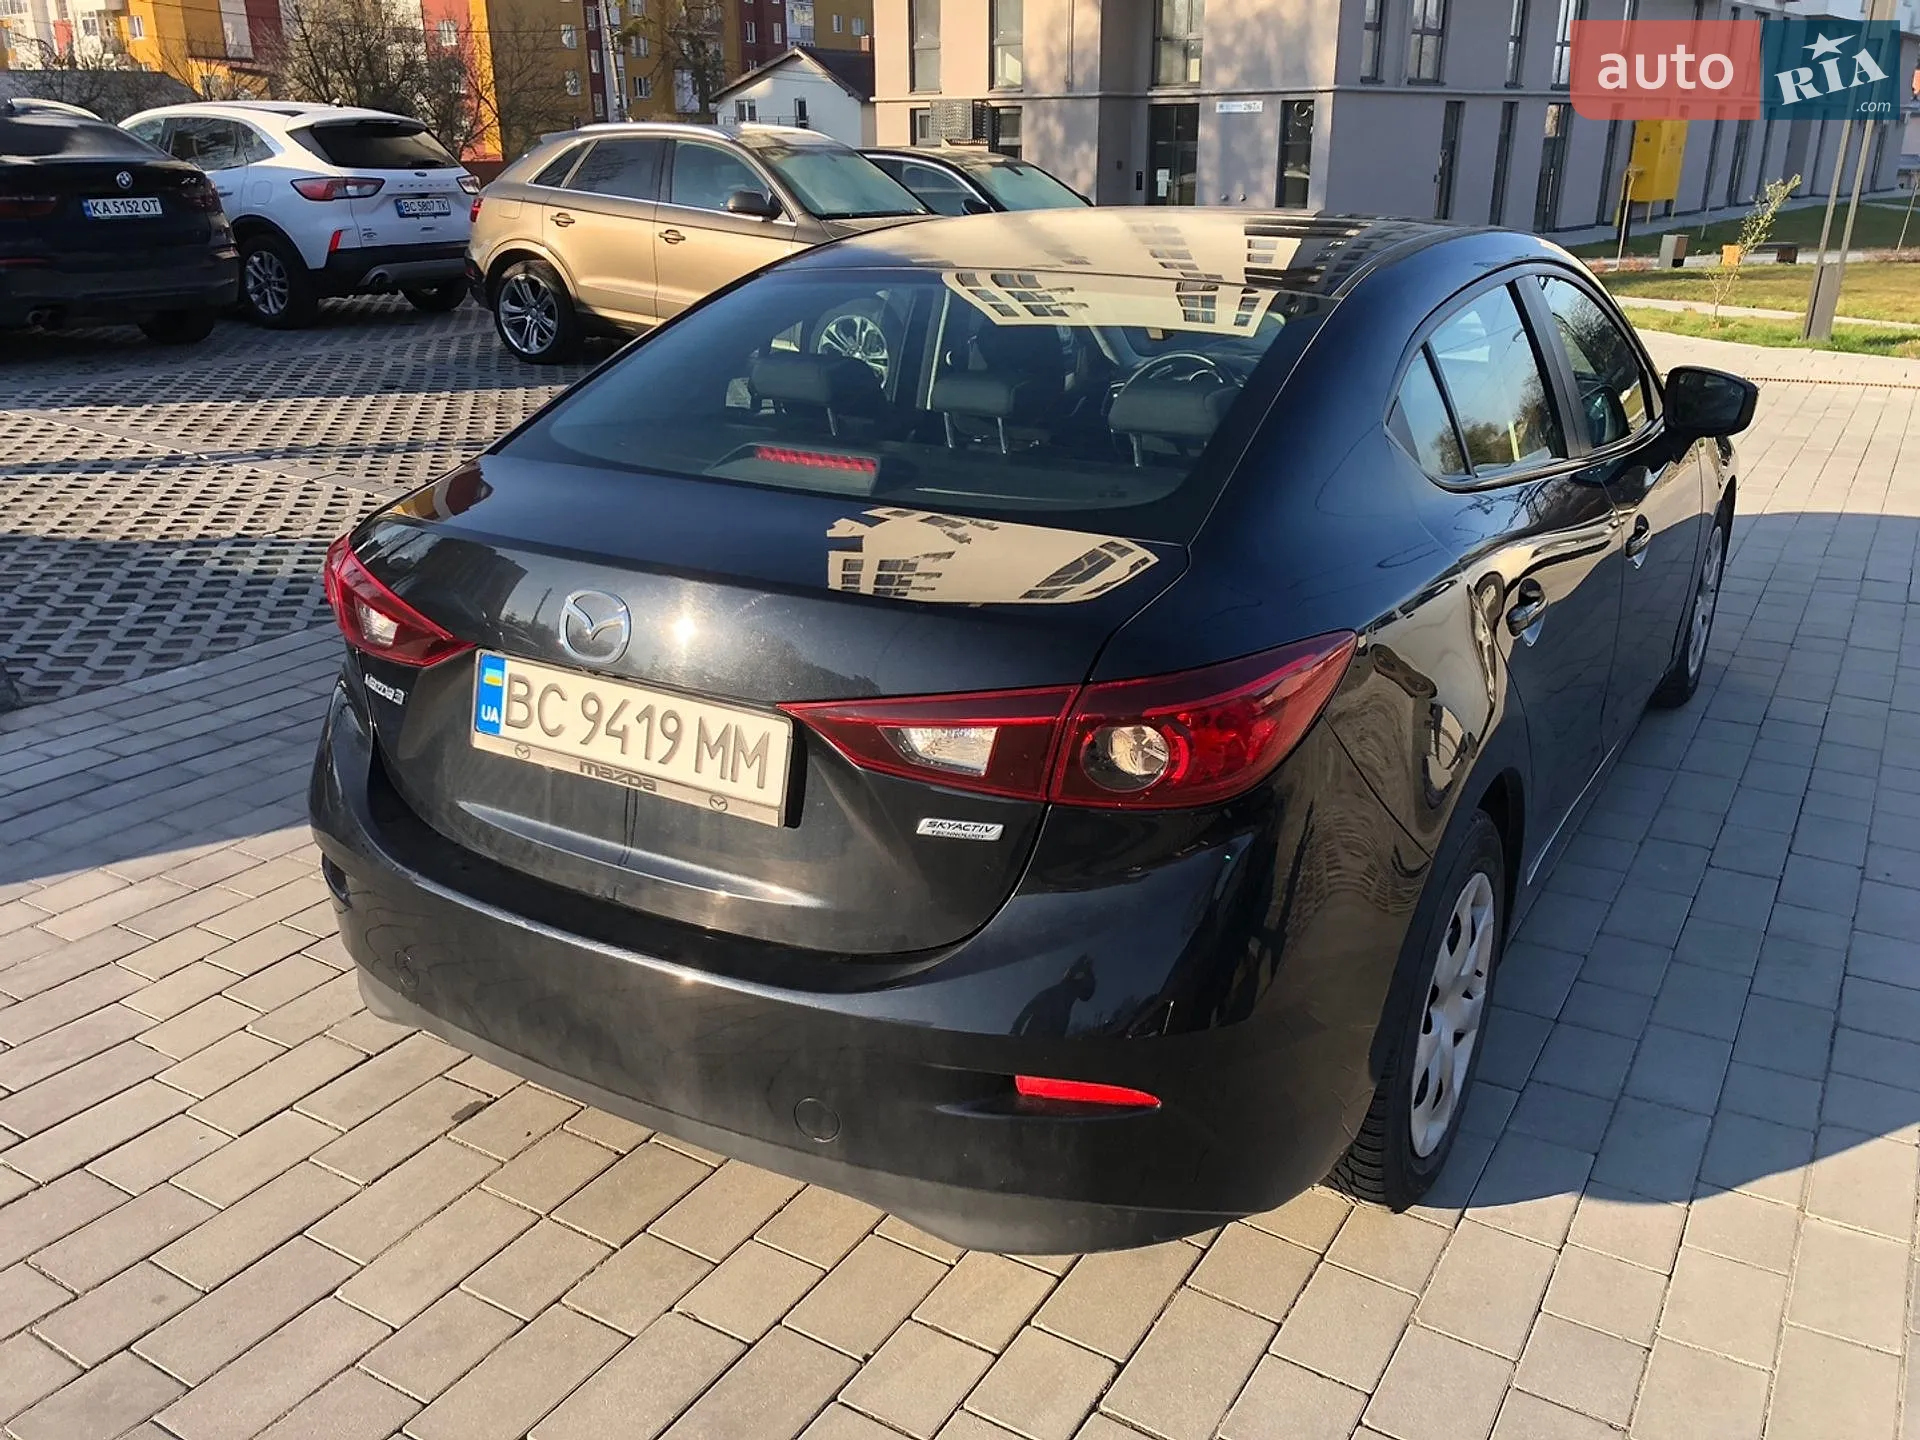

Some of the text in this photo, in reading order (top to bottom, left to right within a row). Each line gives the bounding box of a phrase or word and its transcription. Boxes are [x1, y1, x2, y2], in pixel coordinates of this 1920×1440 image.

[90, 199, 158, 215] KA 5152 OT
[481, 704, 499, 724] UA
[504, 672, 770, 790] BC 9419 MM
[927, 821, 995, 833] SKYACTIV
